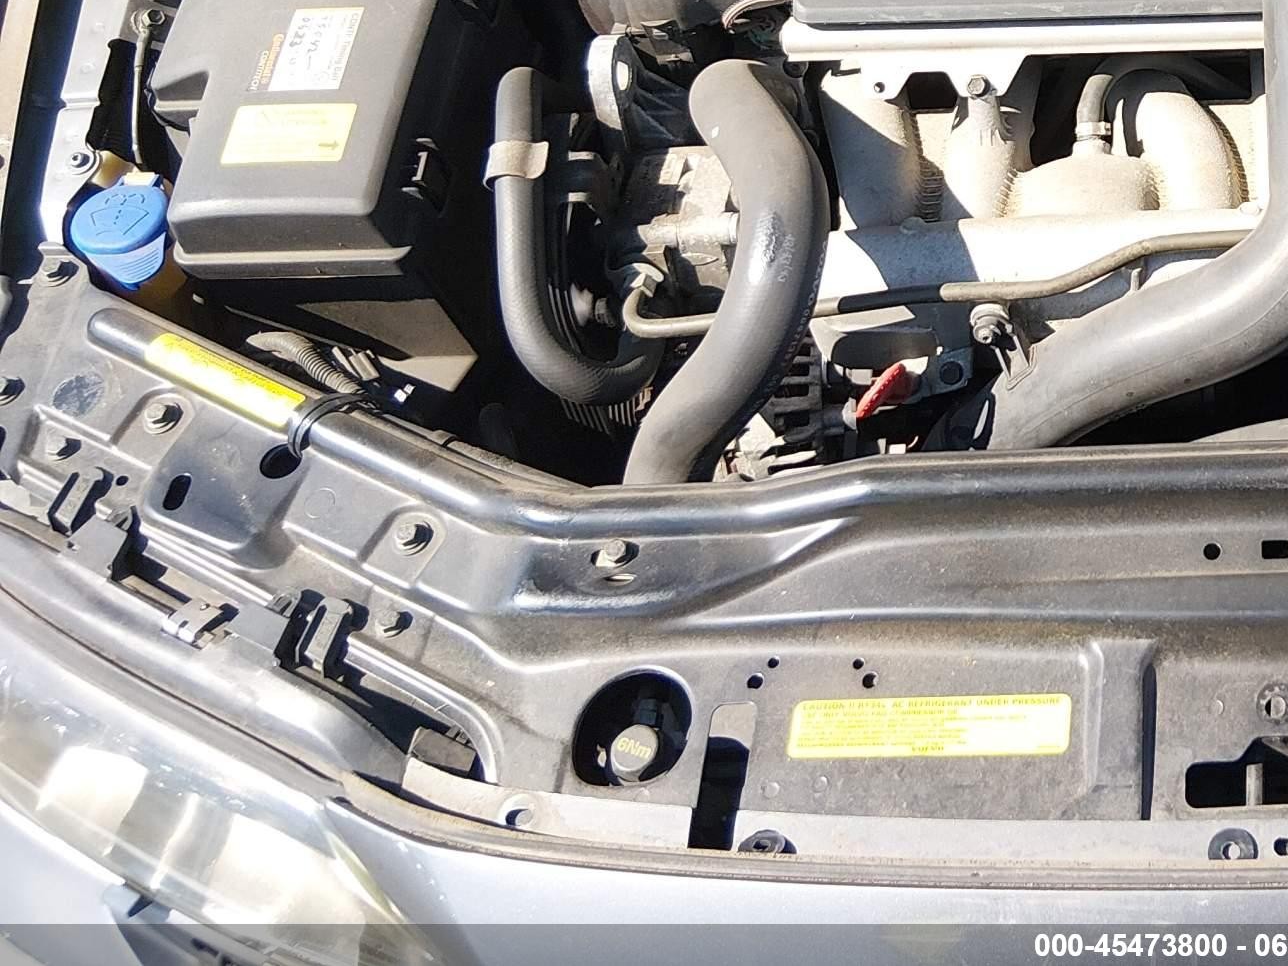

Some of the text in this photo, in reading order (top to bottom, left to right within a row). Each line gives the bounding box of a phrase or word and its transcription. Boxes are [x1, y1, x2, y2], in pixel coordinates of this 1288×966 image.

[976, 698, 1010, 707] UNDER
[1012, 697, 1060, 706] PRESSURE
[617, 737, 652, 759] 6Nm
